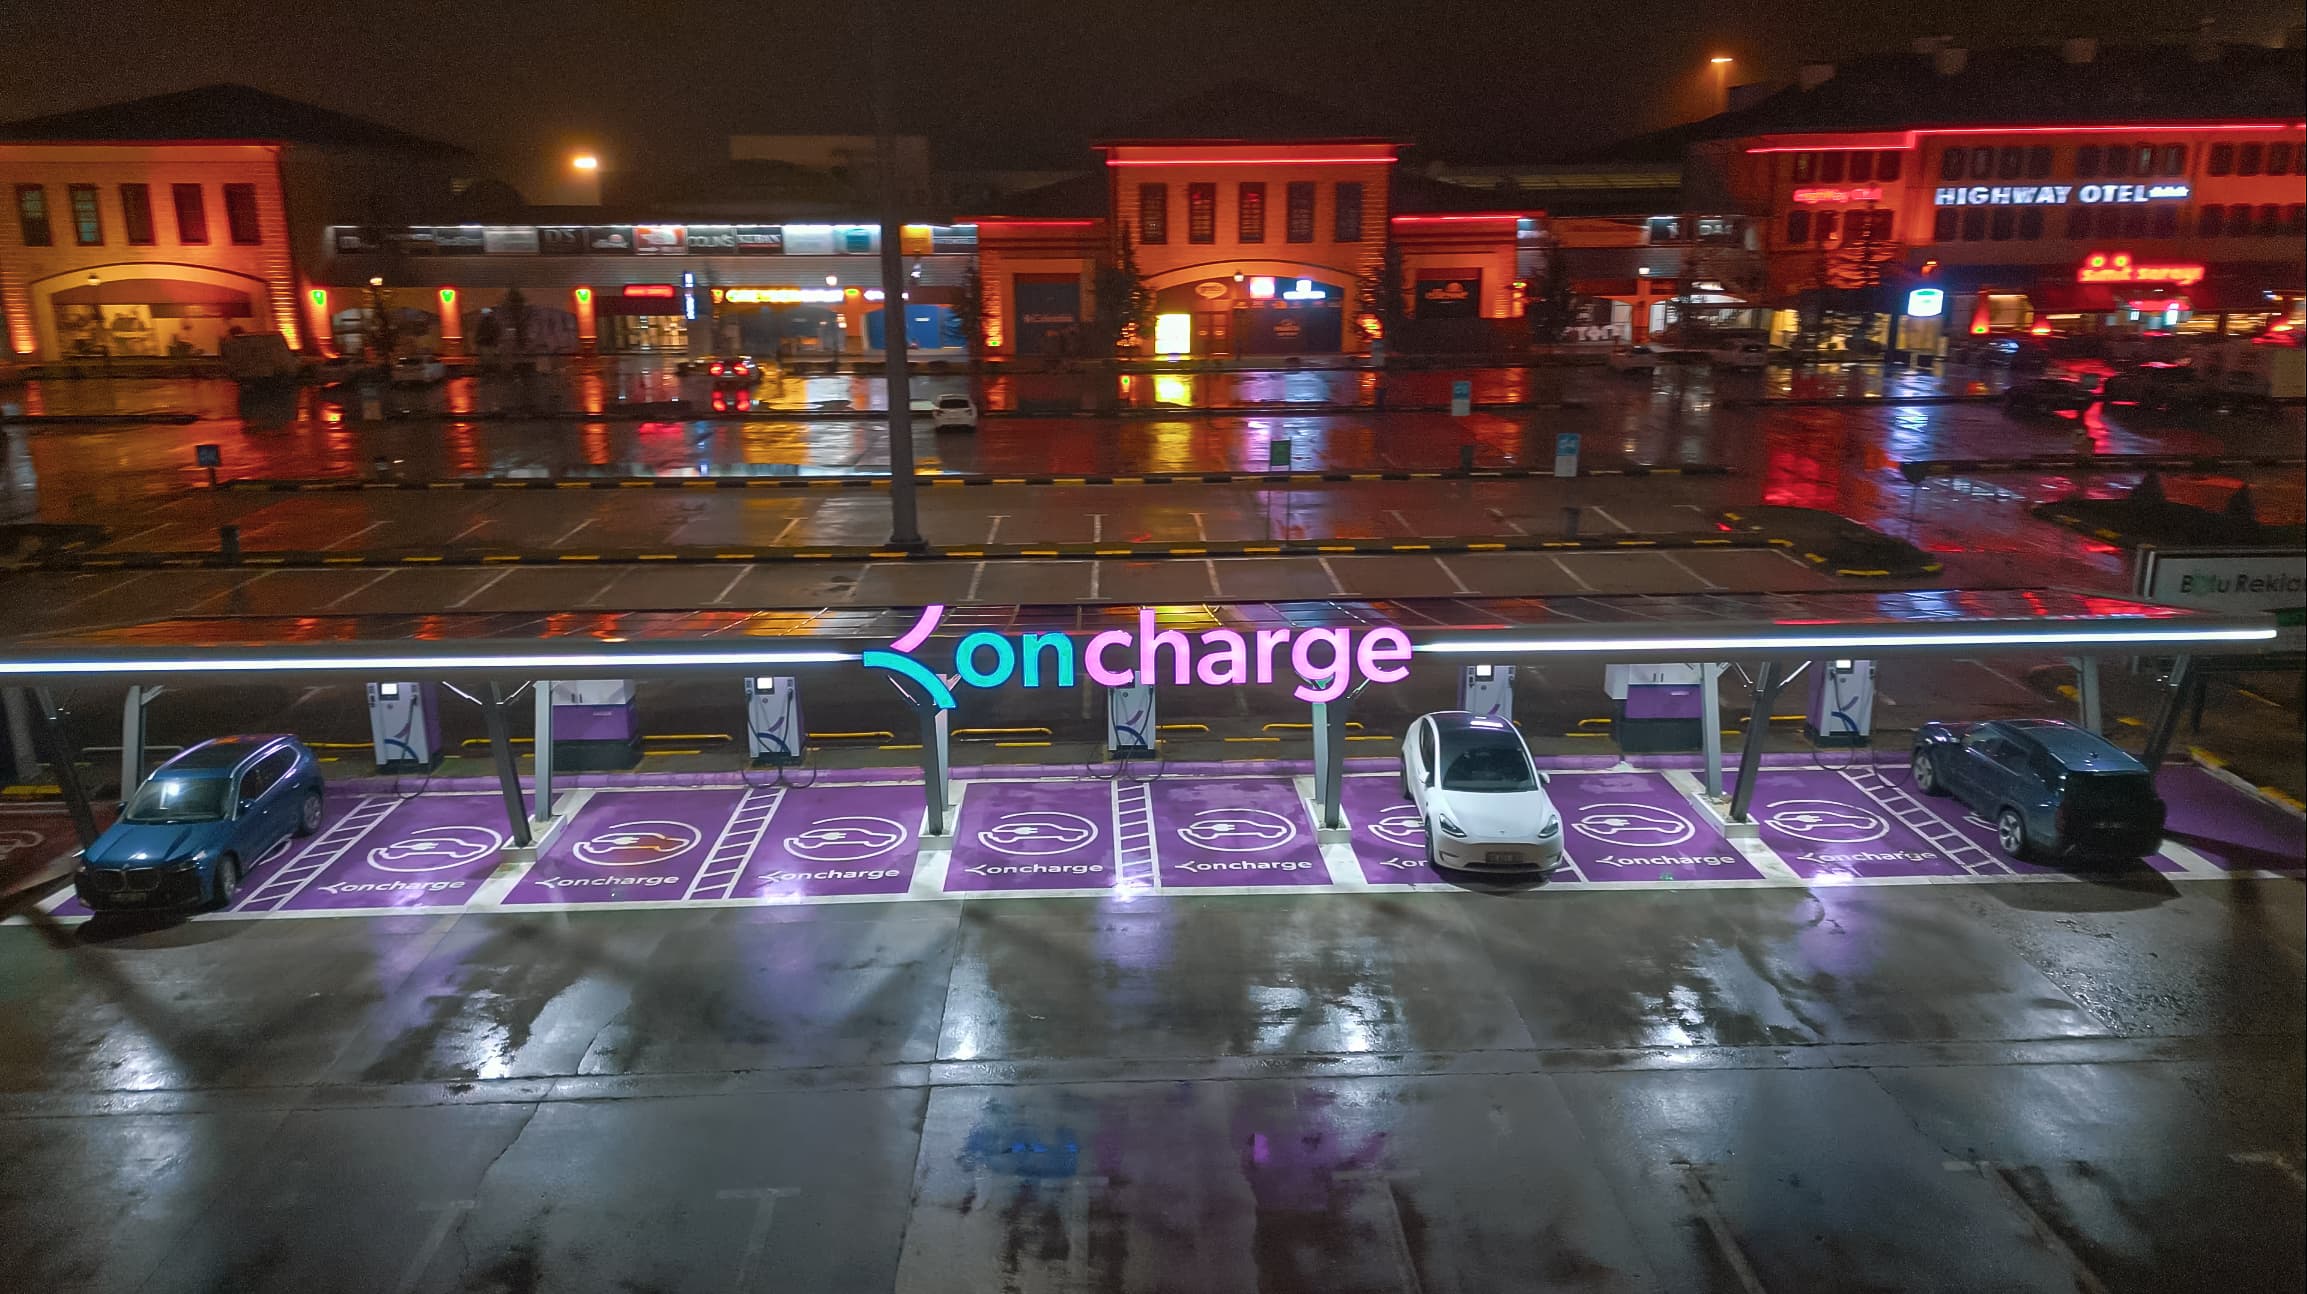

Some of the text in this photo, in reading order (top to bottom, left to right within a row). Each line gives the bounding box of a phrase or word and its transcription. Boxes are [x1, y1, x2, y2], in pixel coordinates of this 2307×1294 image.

[1934, 185, 2149, 205] HIGHWAY OTEL
[955, 608, 1414, 702] oncharge
[1617, 855, 1736, 866] oncharge
[1818, 850, 1937, 861] oncharge
[986, 863, 1103, 874] oncharge
[1196, 860, 1313, 871] oncharge
[557, 875, 680, 887] oncharge
[780, 869, 900, 881] oncharge
[340, 880, 466, 892] oncharge
